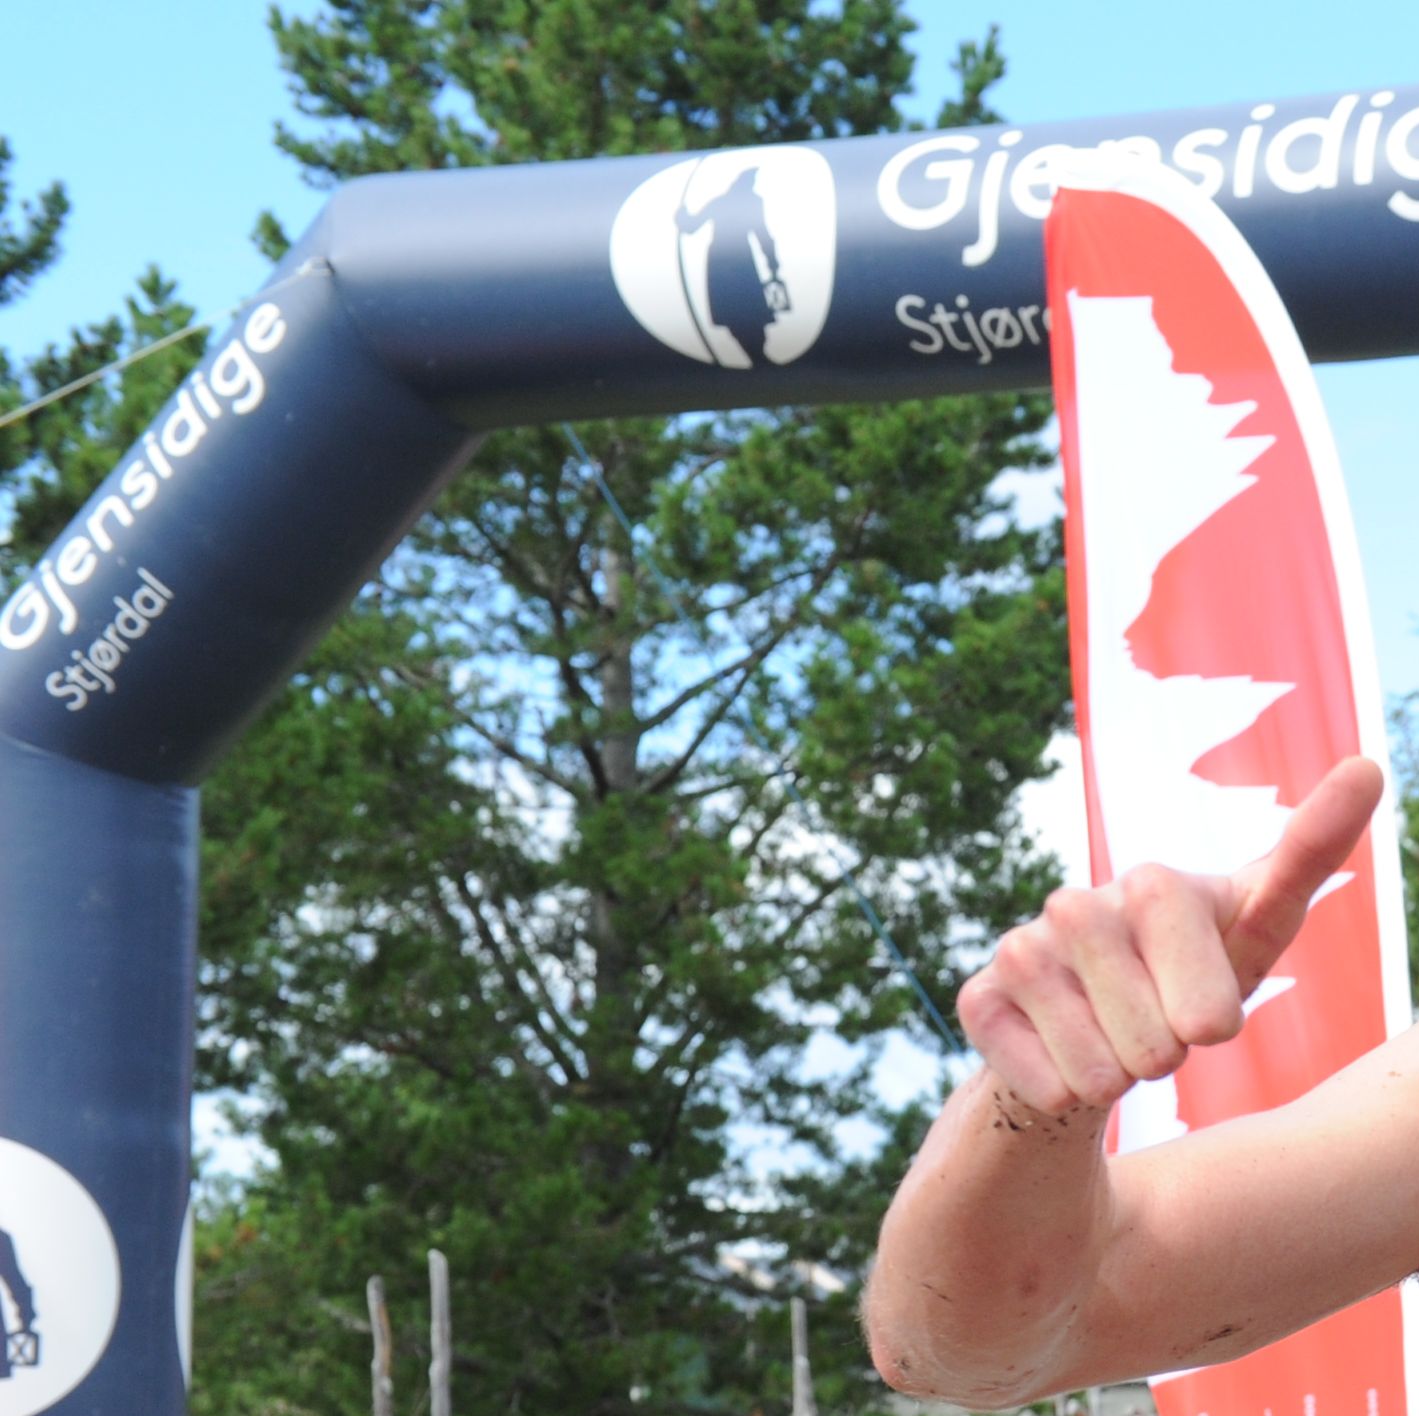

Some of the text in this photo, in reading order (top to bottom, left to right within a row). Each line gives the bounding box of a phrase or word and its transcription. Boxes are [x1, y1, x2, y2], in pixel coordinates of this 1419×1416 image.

[896, 294, 1051, 363] Stjør
[0, 302, 286, 651] Gjensidige
[45, 568, 173, 711] Stjørdal
